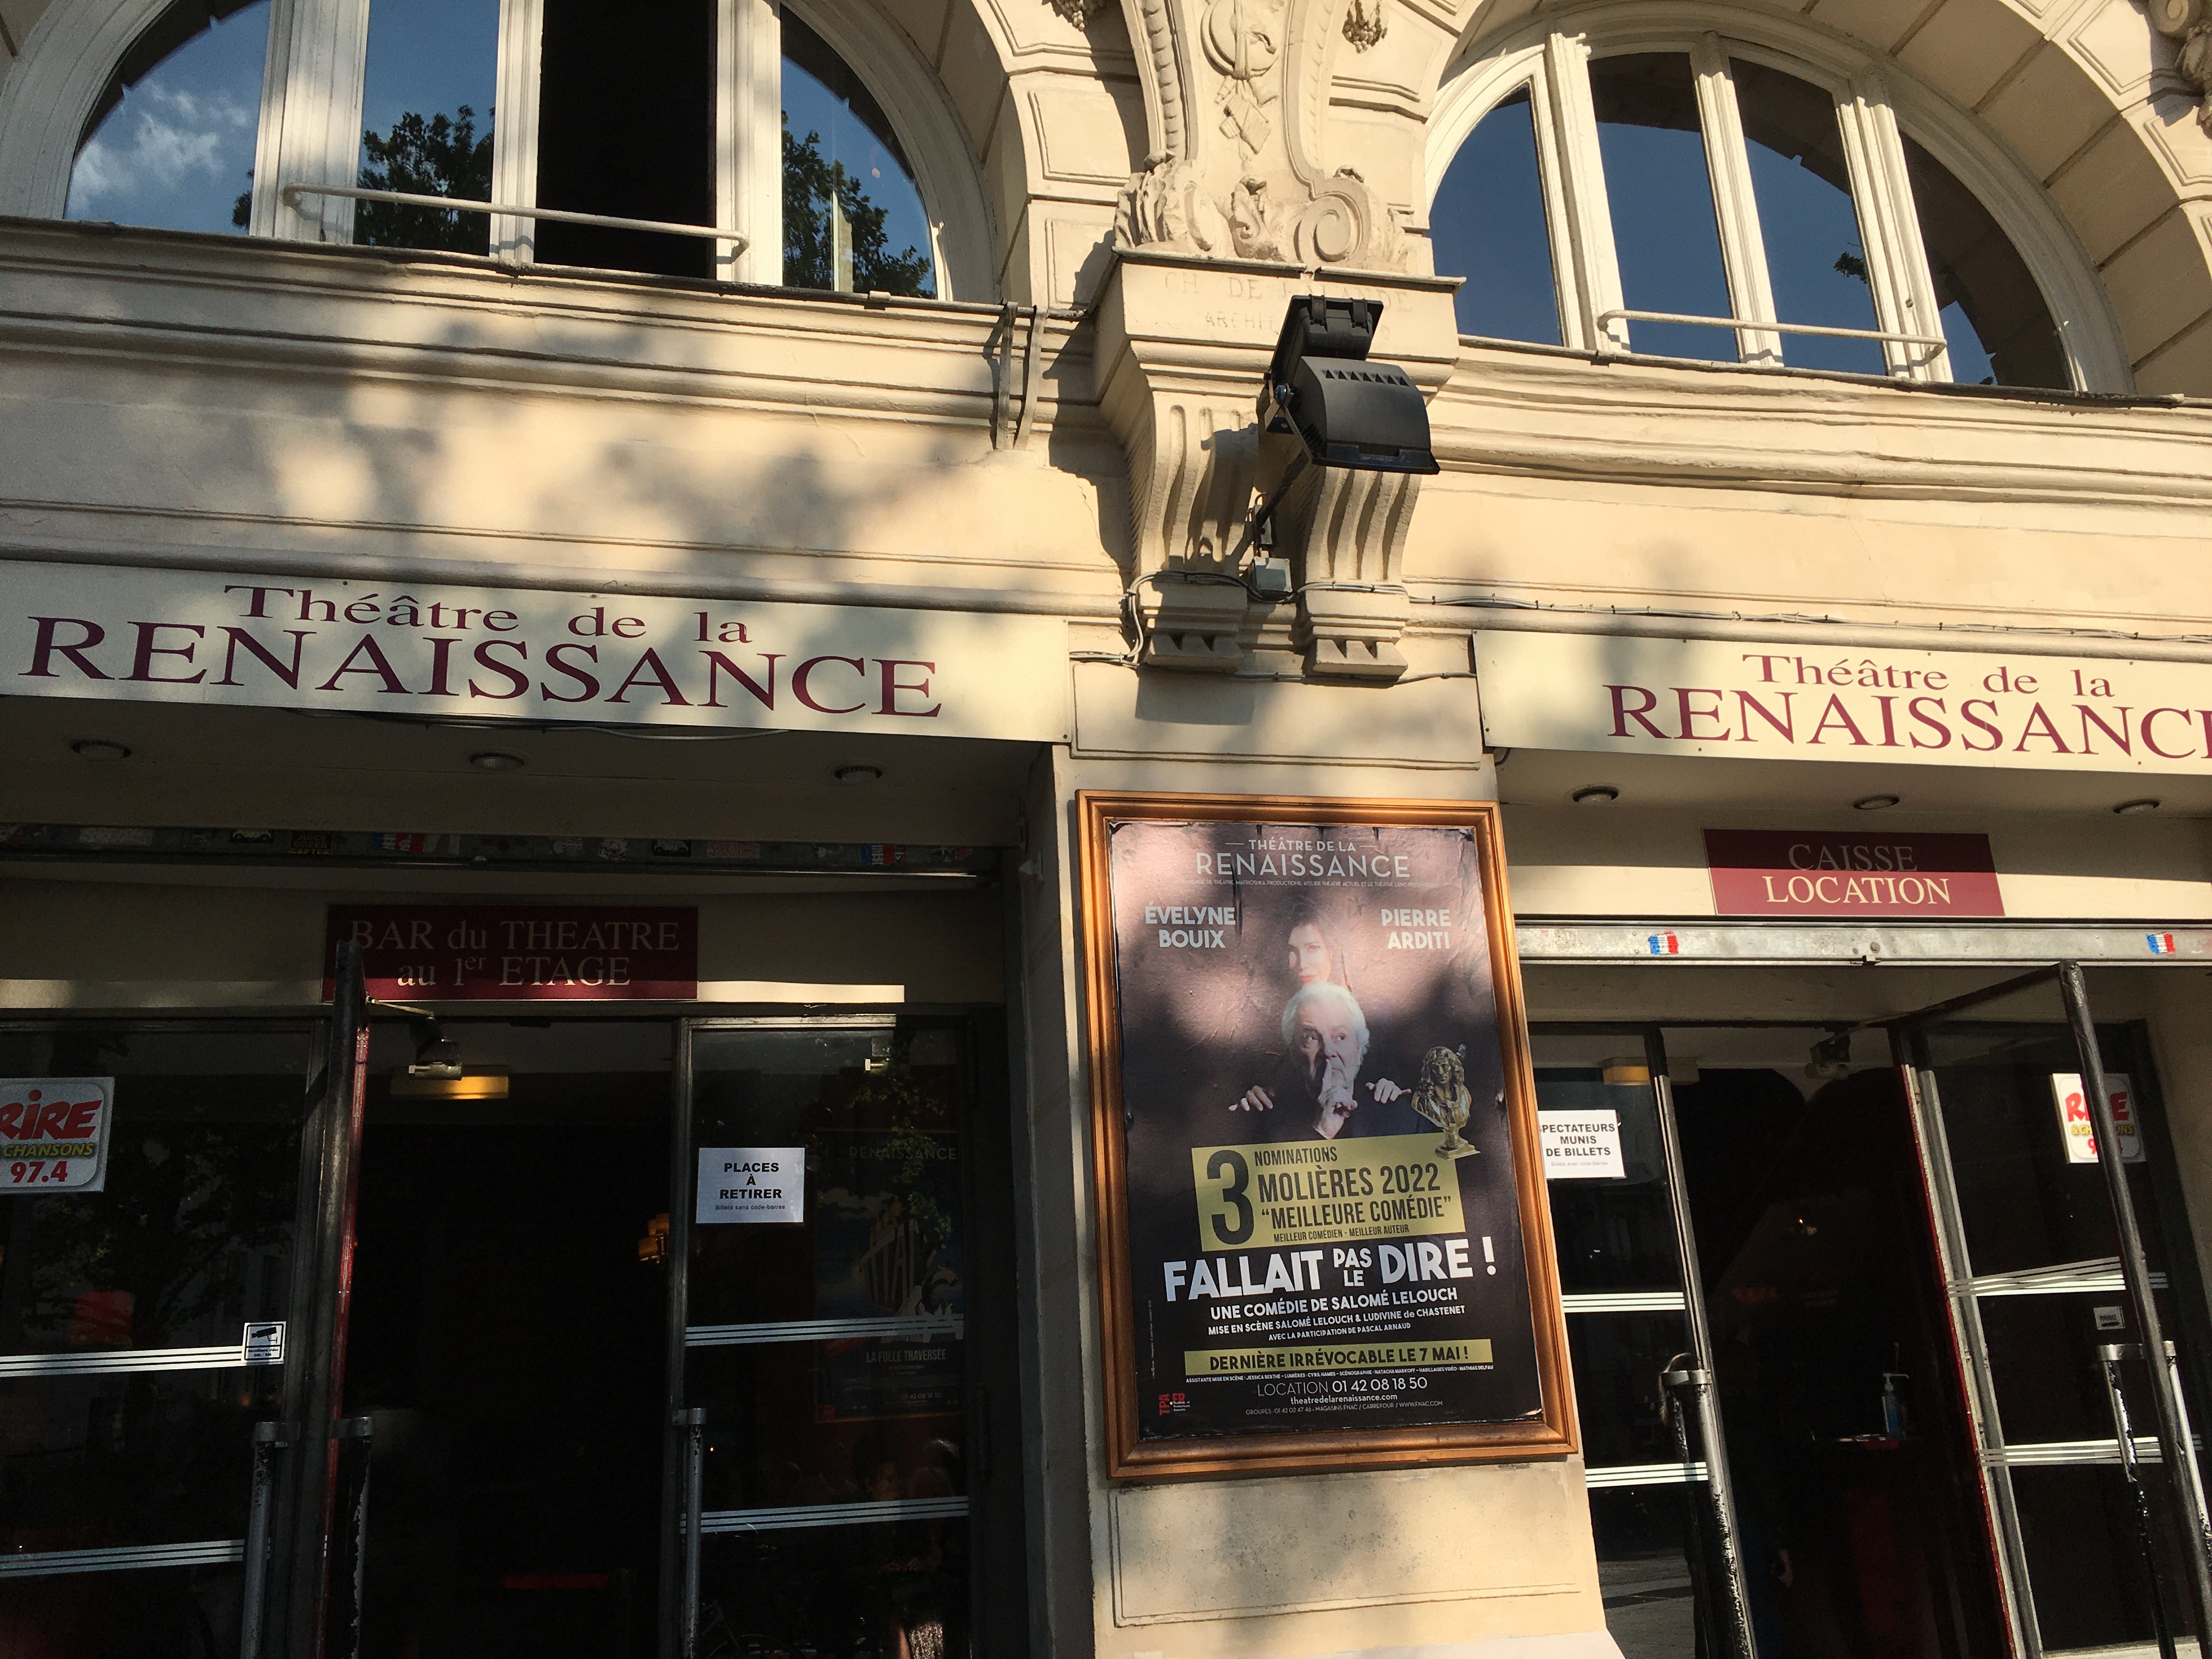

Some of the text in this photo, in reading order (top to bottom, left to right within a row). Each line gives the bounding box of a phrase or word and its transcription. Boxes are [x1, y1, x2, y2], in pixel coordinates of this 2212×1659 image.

[224, 584, 752, 644] Théâtre de la
[18, 616, 943, 718] RENAISSANCE
[1742, 653, 2115, 698] Théâtre de la
[1601, 684, 2212, 760] RENAISSANC
[1248, 837, 1357, 853] THÉÂTRE DE LA
[1195, 852, 1410, 879] RENAISSANCE
[1788, 843, 1918, 872] CAISSE
[1762, 876, 1951, 905] LOCATION
[1144, 901, 1236, 926] ÉVELYNE
[1381, 909, 1452, 927] PIERRE
[349, 919, 680, 950] BAR du THEATRE
[1158, 929, 1226, 949] BOUIX
[1387, 930, 1450, 950] ARDITI
[397, 955, 630, 987] au 1er ETAGE
[3, 1143, 95, 1157] CHANSONS
[1560, 1136, 1597, 1144] MUNIS
[850, 1146, 957, 1160] RENAISSANCE
[1546, 1147, 1611, 1156] DE BILLETS
[10, 1161, 67, 1183] 97.4
[724, 1162, 780, 1173] PLACES
[746, 1173, 757, 1186] À
[1257, 1163, 1441, 1203] MOLIÈRES 2022
[719, 1188, 782, 1200] RETIRER
[1206, 1146, 1338, 1245] 3 NOMINATIONS
[1273, 1232, 1307, 1243] MEILLEUR
[1308, 1228, 1343, 1240] COMÉDIEN
[1348, 1226, 1382, 1238] MEILLEUR
[1383, 1224, 1409, 1235] AUTEUR
[1164, 1235, 1497, 1302] FALLAIT PAS DIRE !
[1343, 1268, 1365, 1288] LE
[1210, 1287, 1458, 1321] UNE COMÉDIE DE SALOMÉ LELOUCH
[1208, 1305, 1465, 1336] MISE EN SCÈNE SALOMÉ LELOUCH & LUDIVINE de CHASTENET
[1268, 1333, 1286, 1341] AVEC
[1297, 1328, 1347, 1339] PARTICIPATION
[1347, 1327, 1356, 1335] DE
[1357, 1324, 1383, 1333] PASCAL
[1384, 1322, 1411, 1331] ARNAUD
[866, 1347, 946, 1363] LA FOLLE TRAVERSÉE
[1210, 1346, 1469, 1370] DERNIÈRE IRRÉVOCABLE LE 7 MAI !
[1257, 1376, 1427, 1396] LOCATION 01 42 08 18 50
[1290, 1394, 1398, 1405] theatredelarenaissance.com
